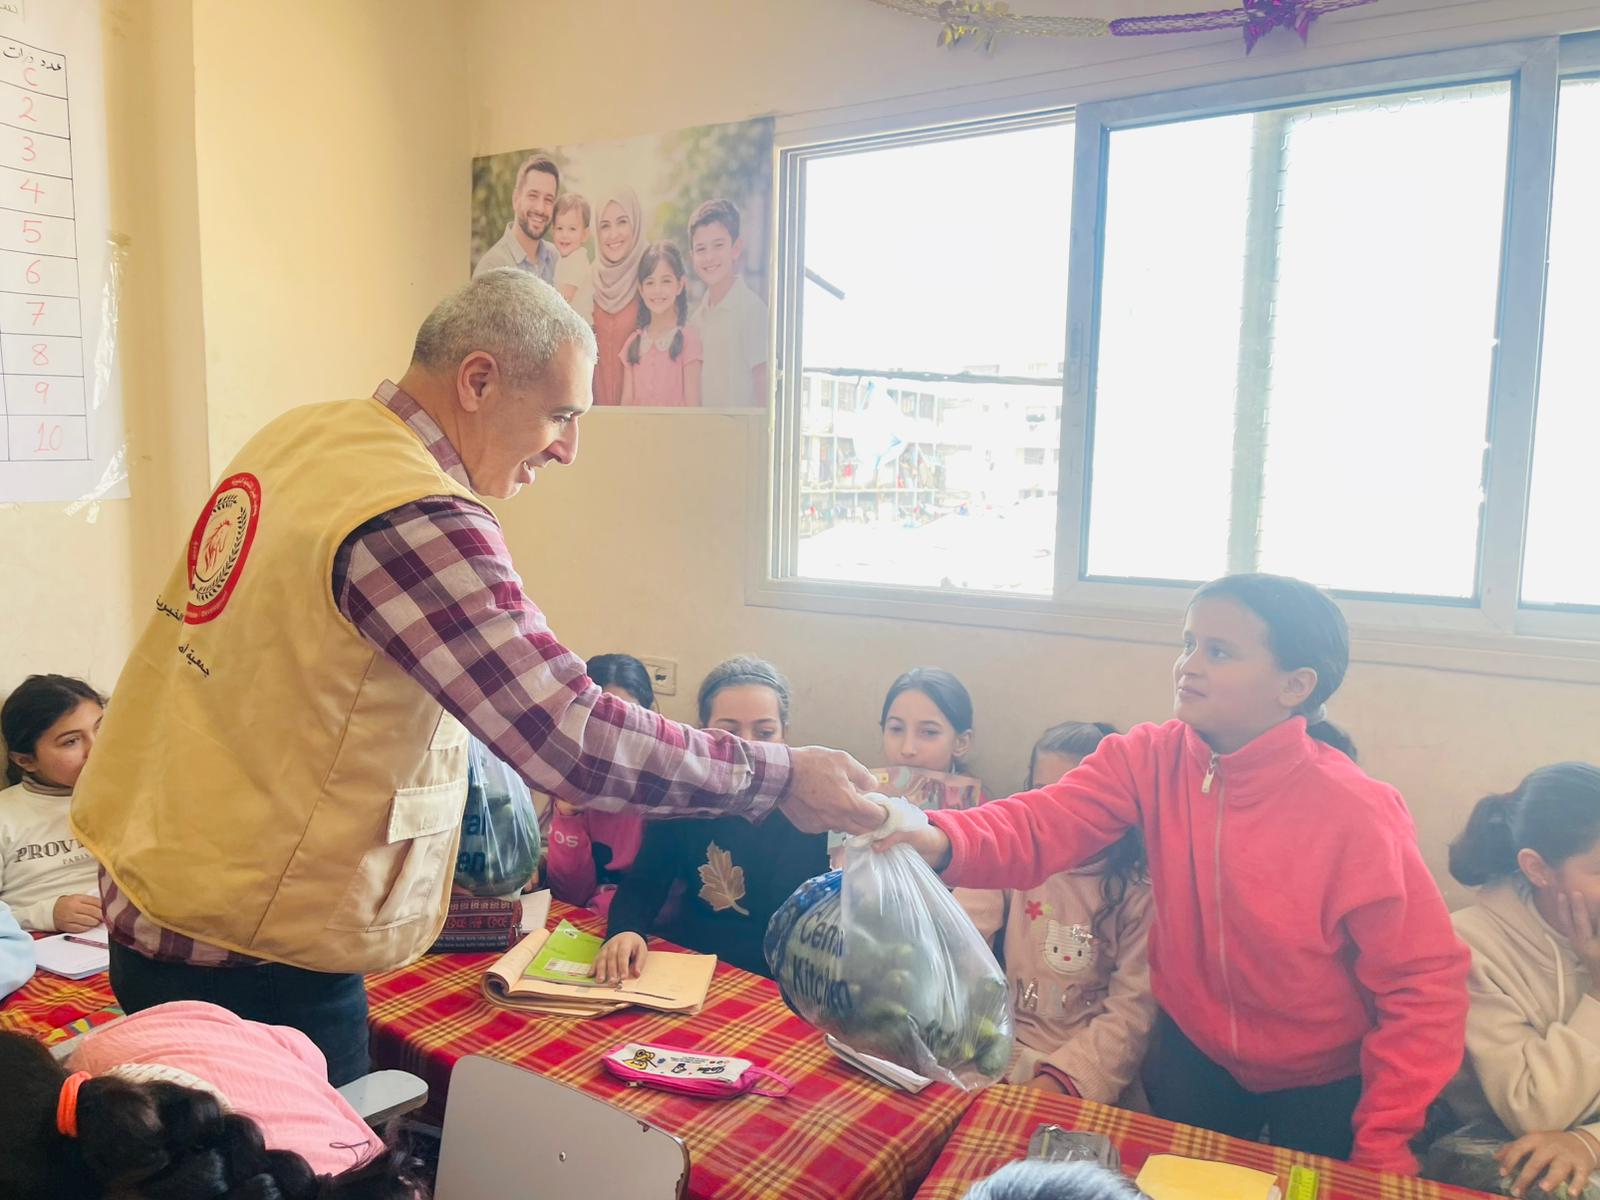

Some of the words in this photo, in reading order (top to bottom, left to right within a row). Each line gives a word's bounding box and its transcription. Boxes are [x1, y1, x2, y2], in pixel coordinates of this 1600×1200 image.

[18, 97, 37, 122] 2
[21, 136, 37, 162] 3
[20, 178, 45, 204] 4
[22, 219, 43, 243] 5
[25, 259, 41, 284] 6
[26, 301, 45, 326] 7
[31, 343, 49, 366] 8
[34, 381, 50, 404] 9
[34, 422, 63, 452] 10
